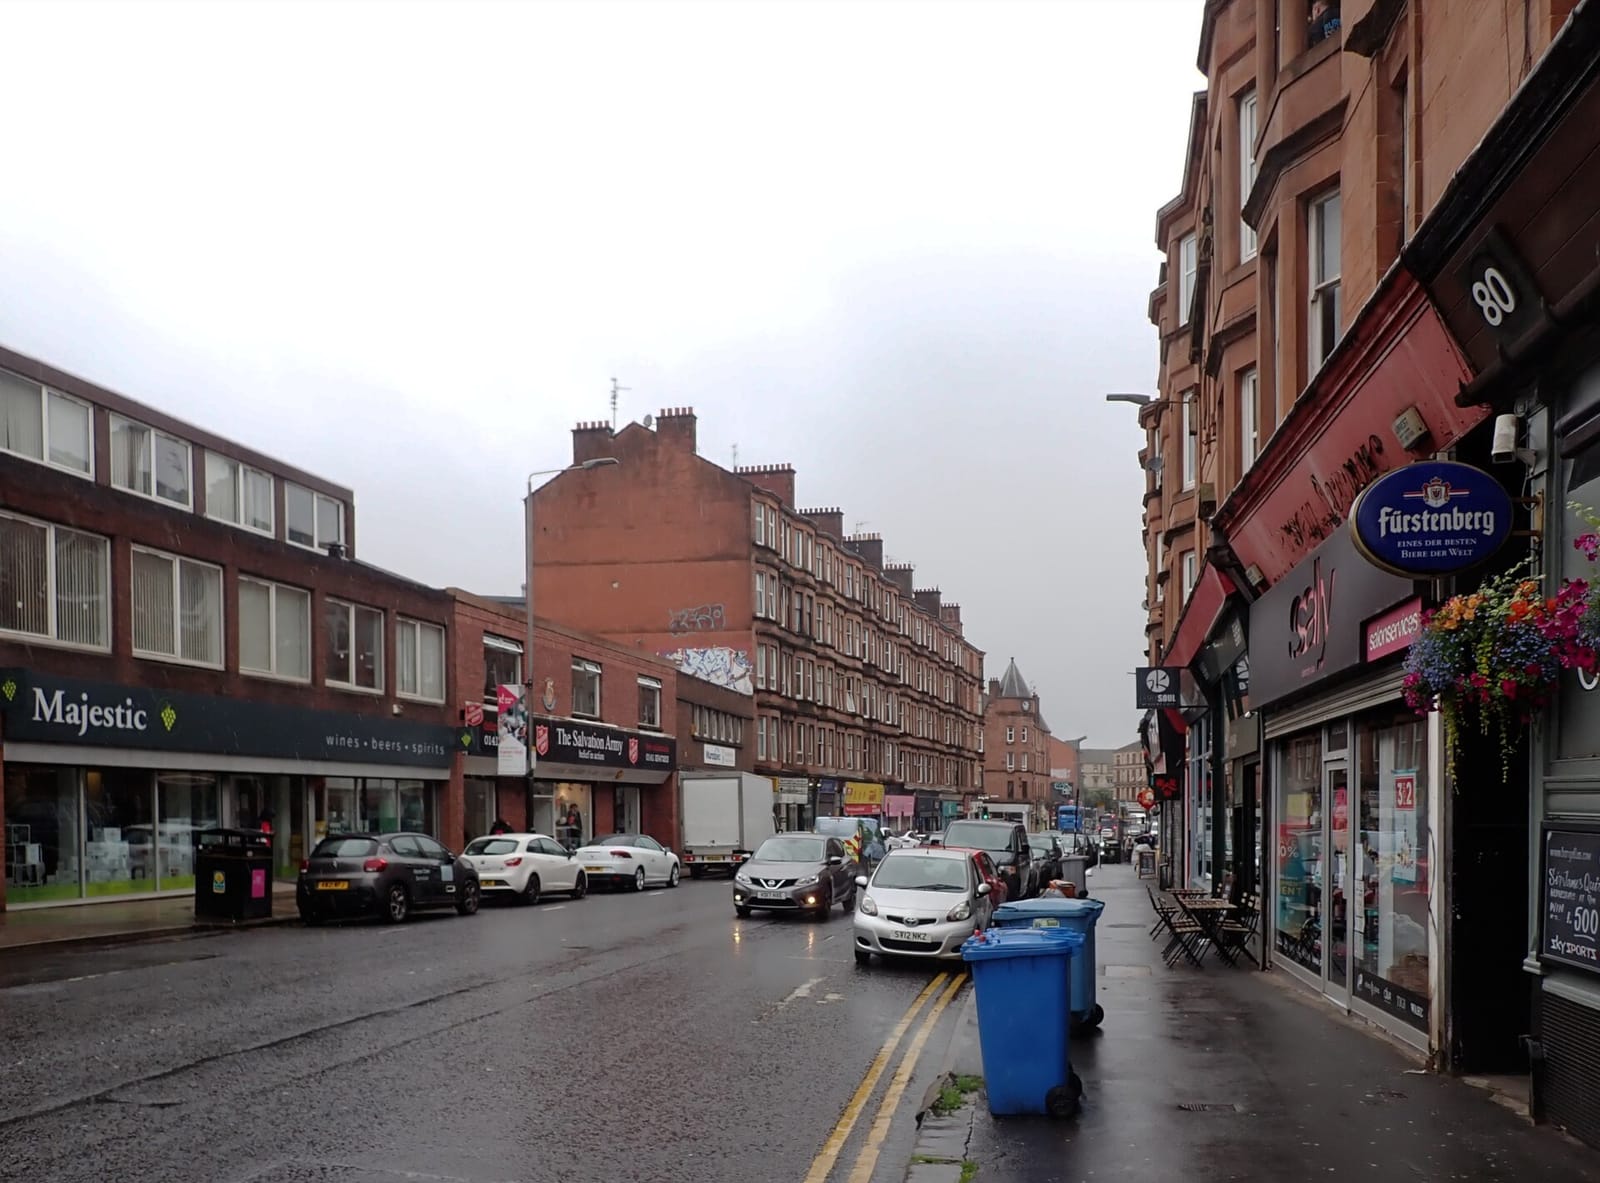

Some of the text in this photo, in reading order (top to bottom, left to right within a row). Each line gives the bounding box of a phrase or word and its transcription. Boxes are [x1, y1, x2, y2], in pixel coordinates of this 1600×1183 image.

[1472, 267, 1515, 327] 80
[1378, 505, 1495, 538] Fürstenberg
[1397, 540, 1423, 548] EINES
[1444, 538, 1477, 546] BESTEN
[1430, 549, 1447, 557] DER
[1157, 694, 1176, 703] SOUL
[32, 687, 147, 736] Majestic
[326, 734, 445, 756] wines beers spirits
[556, 727, 572, 746] The
[572, 730, 604, 750] Salvation
[605, 735, 624, 755] Army
